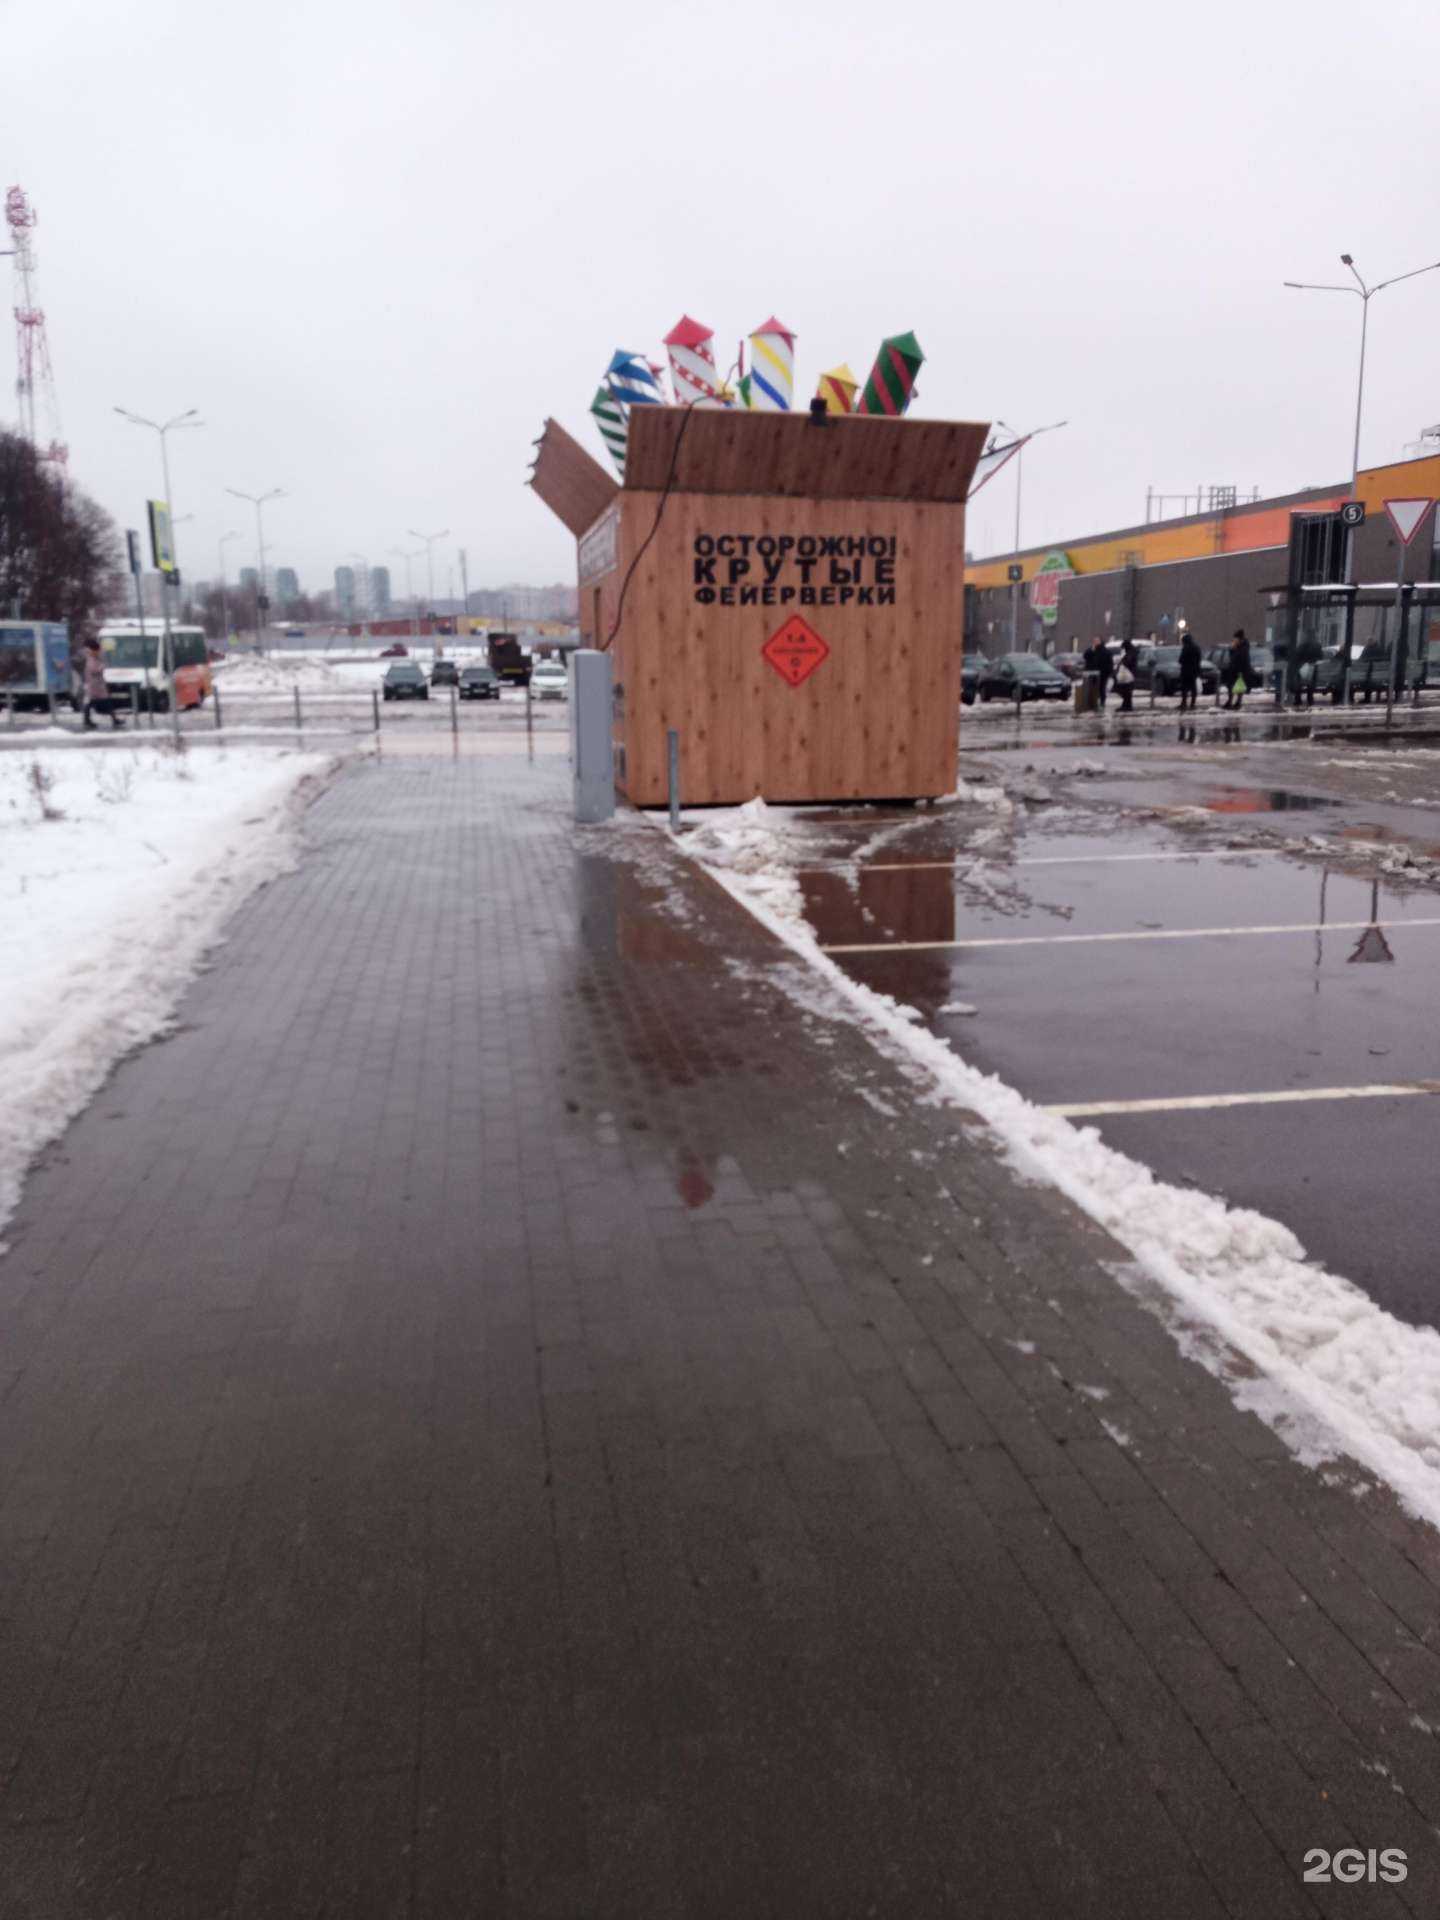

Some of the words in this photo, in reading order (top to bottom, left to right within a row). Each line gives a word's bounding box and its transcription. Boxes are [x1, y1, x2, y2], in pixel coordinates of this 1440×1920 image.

[1348, 507, 1357, 520] 5
[694, 535, 896, 557] ОСТОРОЖНО!
[694, 557, 896, 585] КРУТЫЕ
